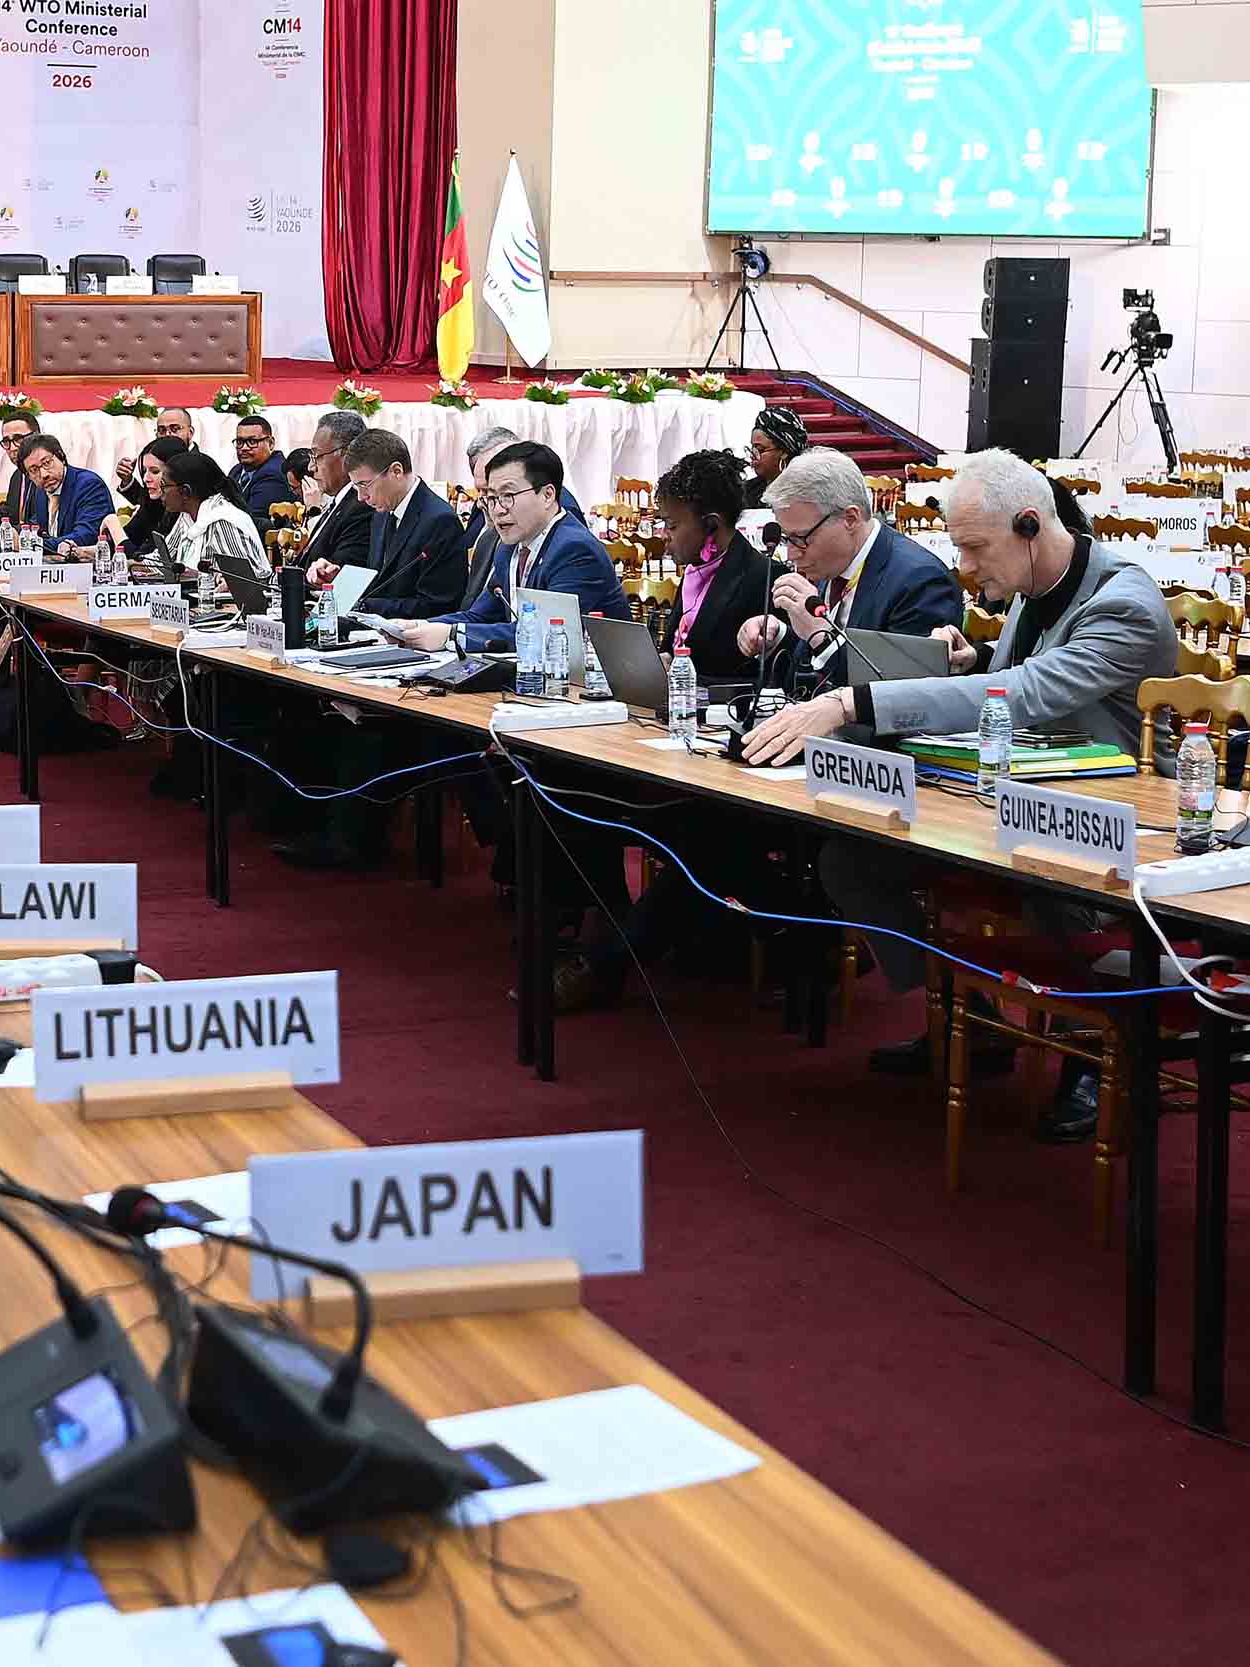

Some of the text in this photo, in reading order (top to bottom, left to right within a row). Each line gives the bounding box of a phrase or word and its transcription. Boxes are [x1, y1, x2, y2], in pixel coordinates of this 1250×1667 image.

[20, 0, 61, 14] WTO
[65, 1, 147, 18] Ministerial
[25, 19, 118, 36] Conference
[263, 17, 302, 34] CM14
[72, 40, 150, 57] Cameroon
[52, 74, 92, 88] 2026
[276, 220, 301, 233] 2026
[1148, 517, 1197, 530] OMOROS
[40, 569, 65, 584] FIJI
[812, 749, 906, 798] GRENADA
[1000, 794, 1124, 852] GUINEA-BISSAU
[54, 996, 315, 1060] LITHUANIA
[330, 1164, 555, 1244] JAPAN
